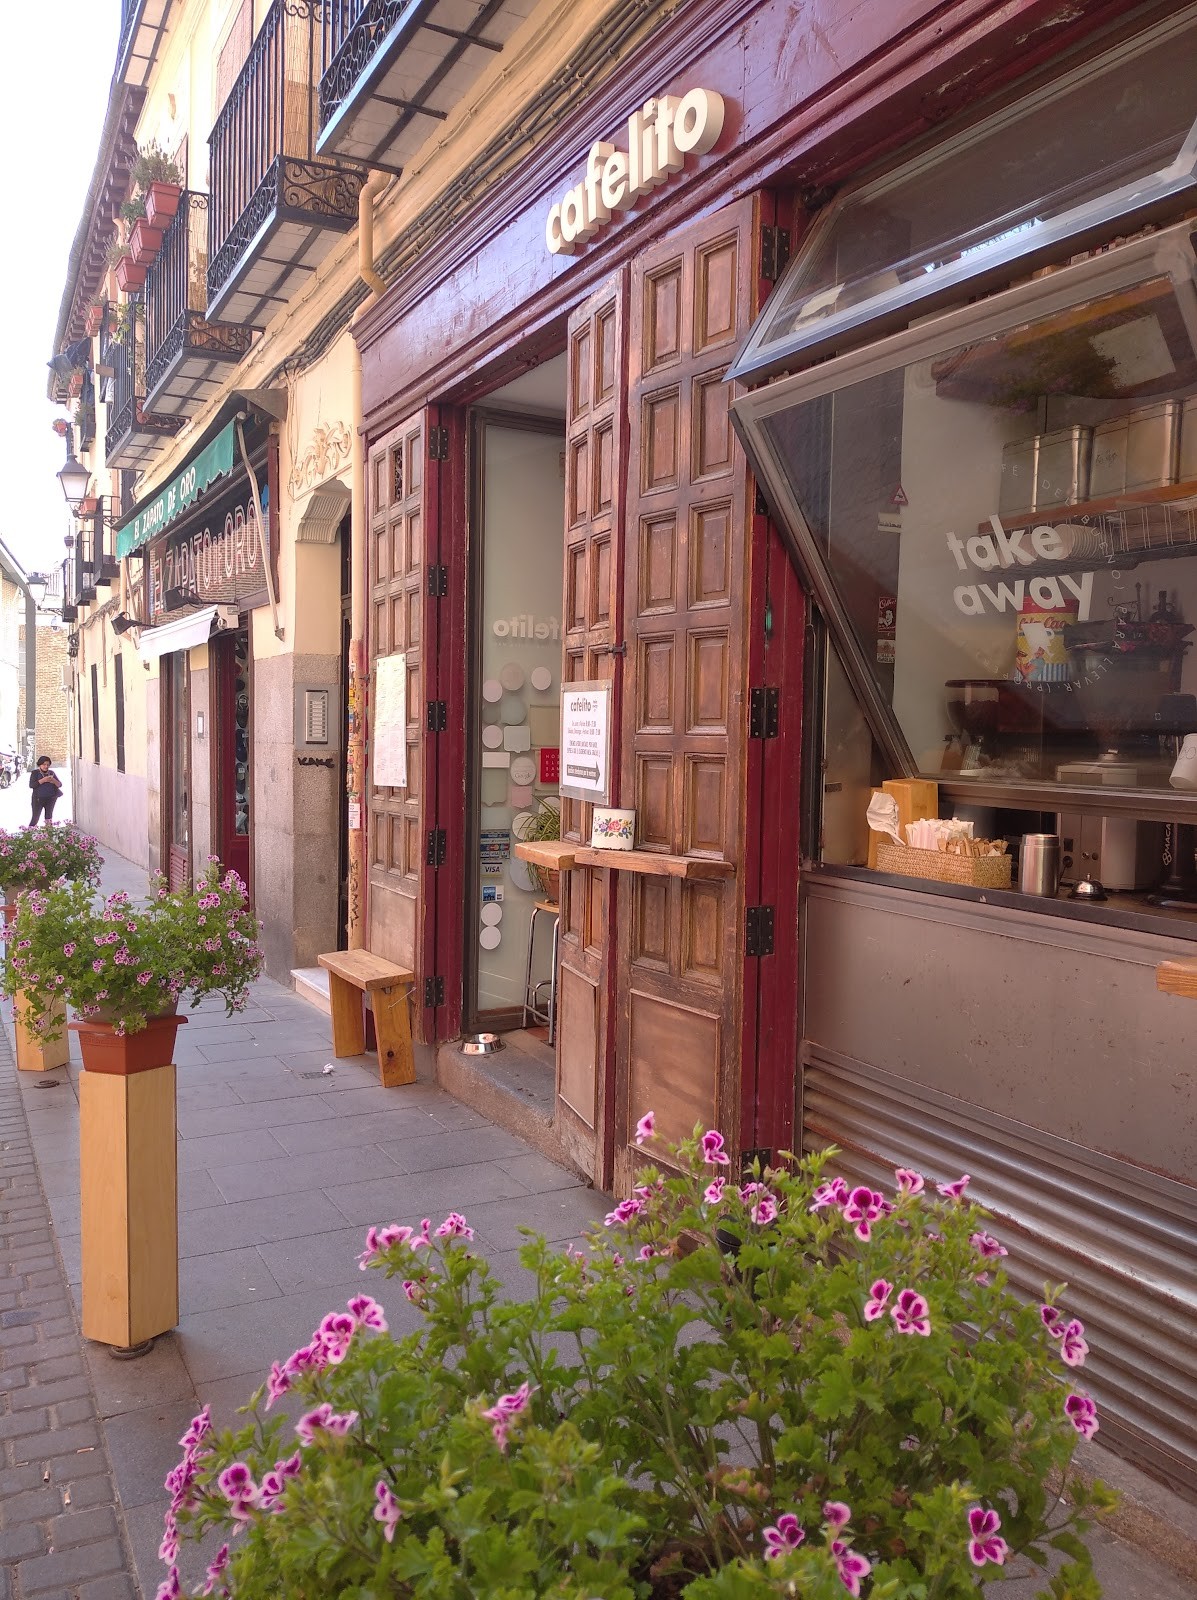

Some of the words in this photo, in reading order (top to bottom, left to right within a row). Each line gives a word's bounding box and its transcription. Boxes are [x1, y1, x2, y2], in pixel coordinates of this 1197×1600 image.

[546, 87, 722, 255] cafelito
[134, 520, 140, 540] EL
[142, 499, 164, 534] ZAPATO
[167, 486, 176, 514] DE
[180, 466, 196, 501] ORO
[165, 528, 211, 597] ZAPATO
[224, 496, 258, 578] ORO
[946, 514, 1063, 571] take
[953, 572, 1094, 621] away
[570, 697, 592, 712] cafelito
